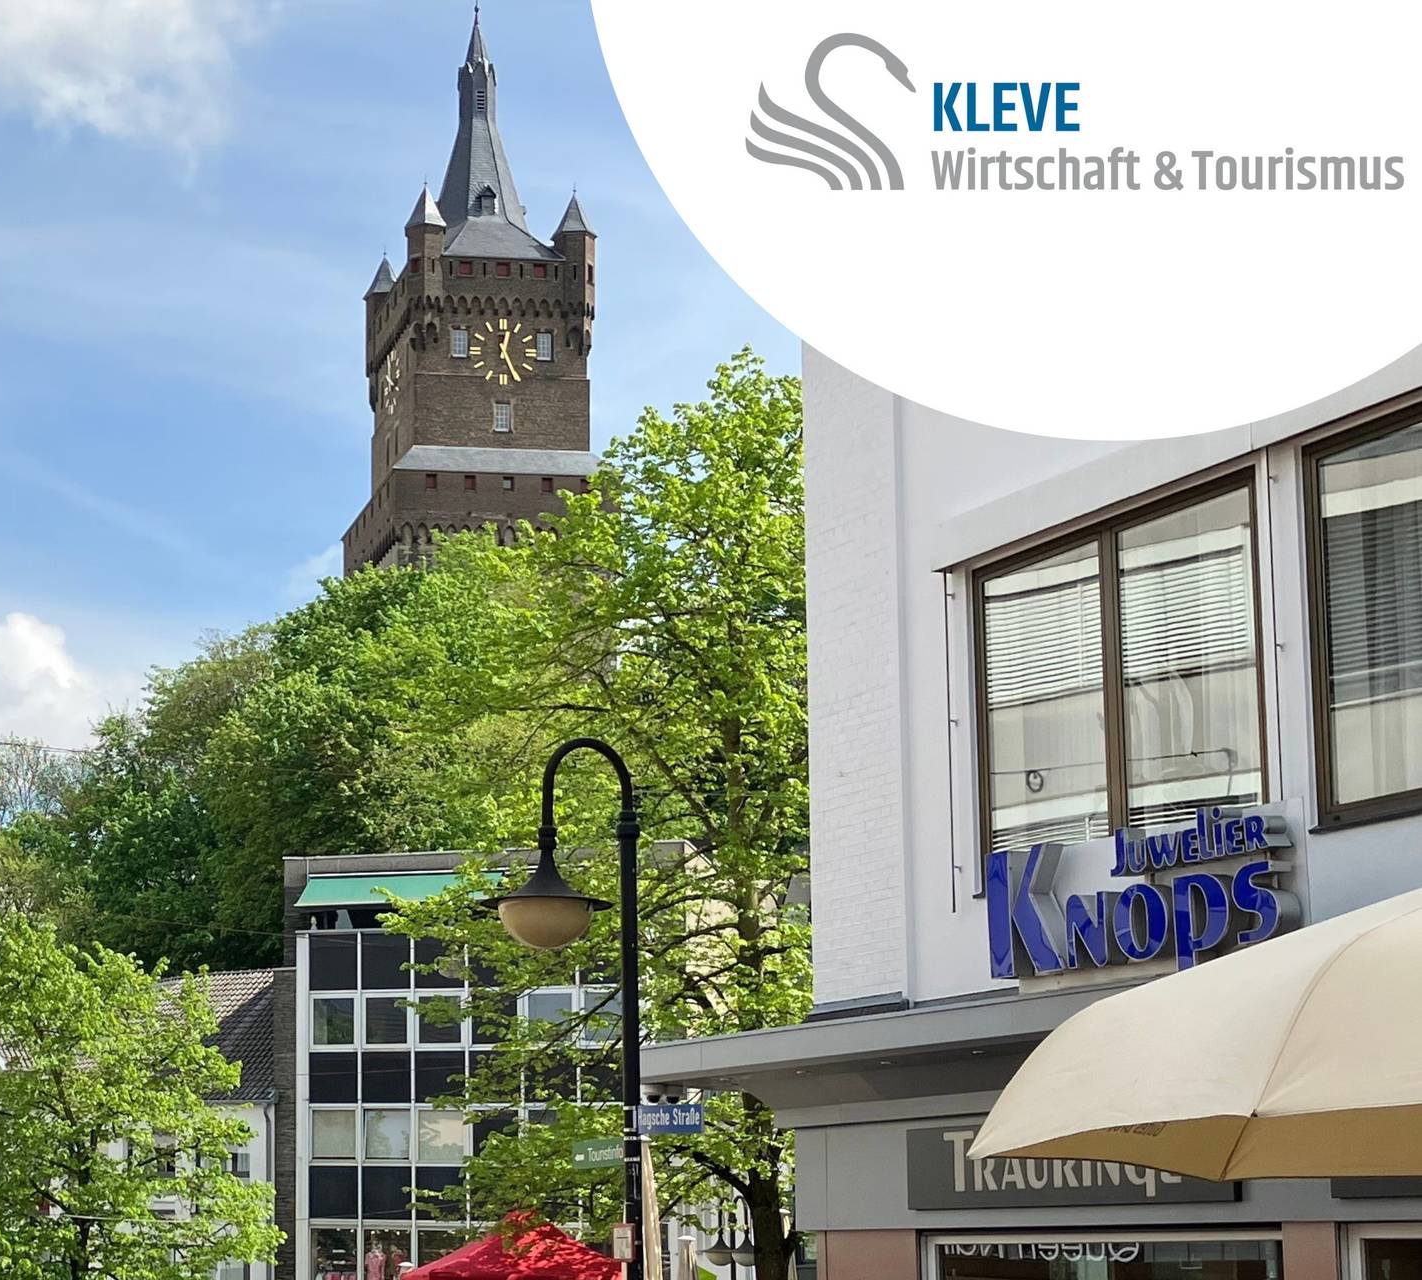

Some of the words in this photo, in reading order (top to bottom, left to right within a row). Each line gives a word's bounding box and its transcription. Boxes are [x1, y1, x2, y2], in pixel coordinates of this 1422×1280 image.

[985, 843, 1280, 979] KNOPS
[638, 1108, 670, 1130] Hagsche
[673, 1107, 700, 1126] Straße
